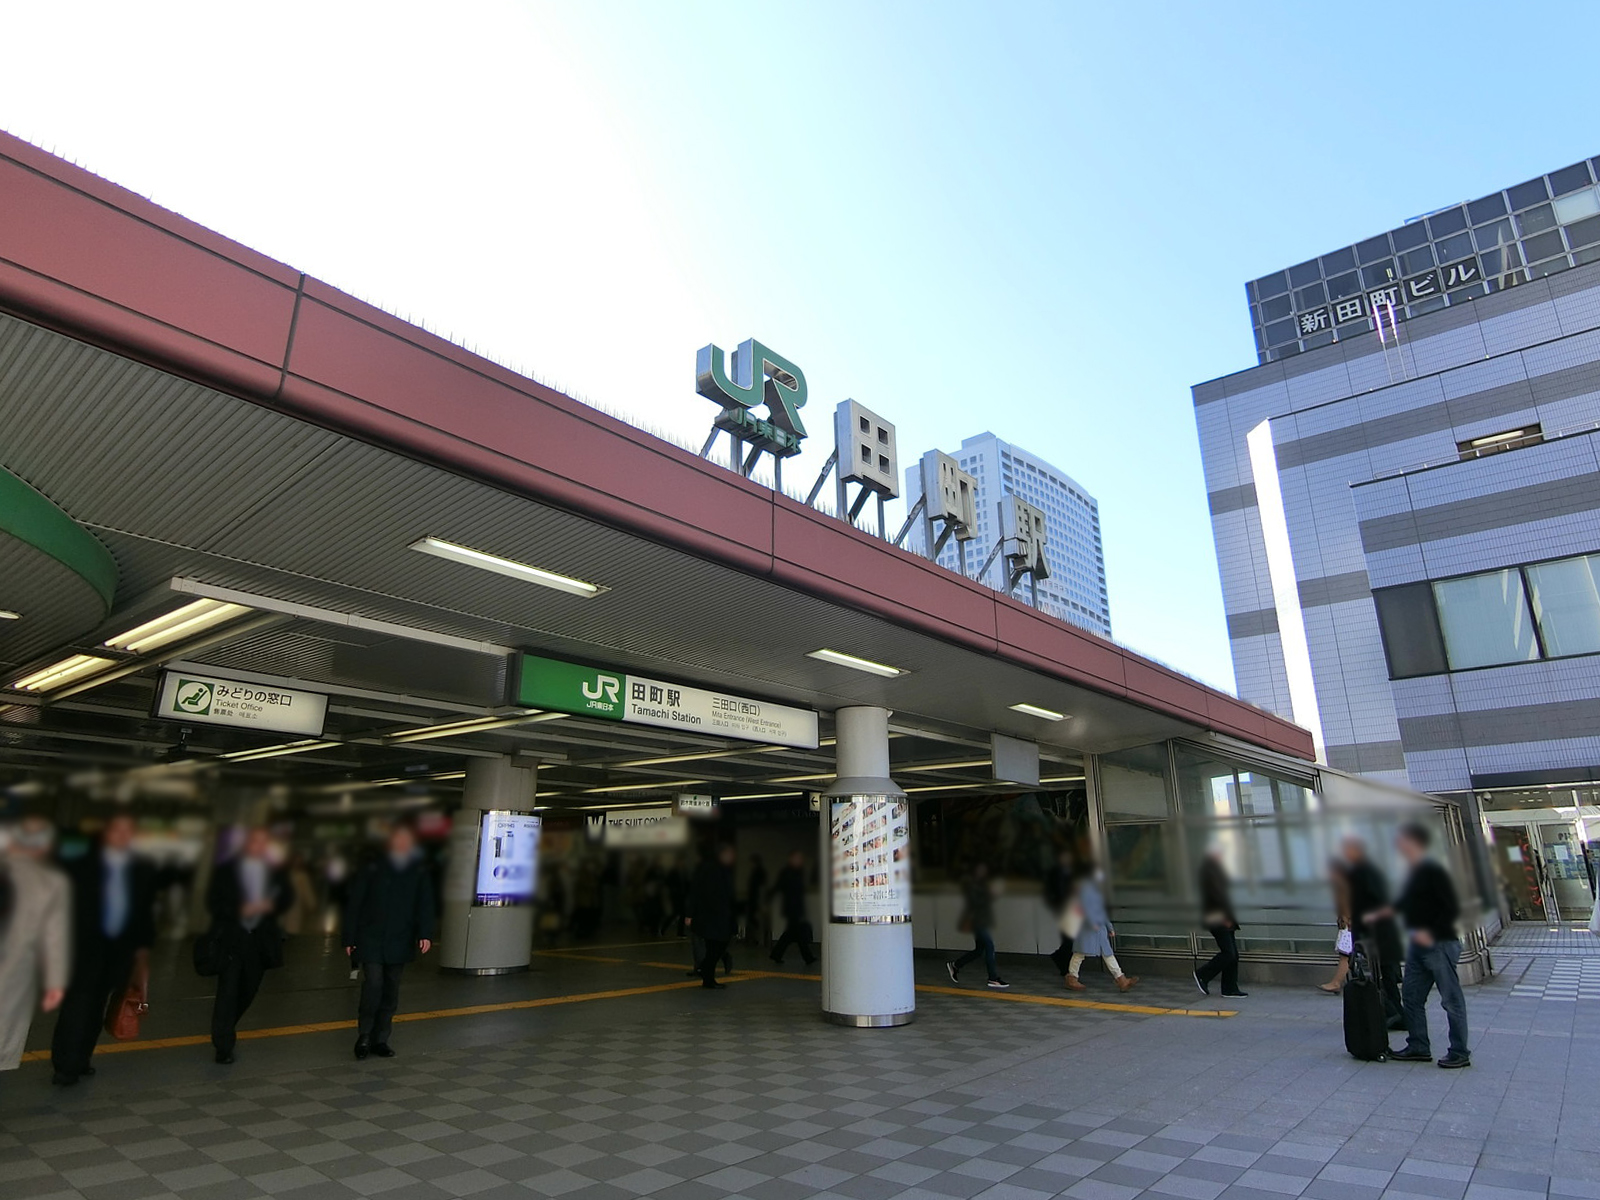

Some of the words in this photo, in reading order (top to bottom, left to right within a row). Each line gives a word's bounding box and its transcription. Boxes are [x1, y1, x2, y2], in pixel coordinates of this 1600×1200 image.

[1300, 264, 1476, 333] 新田町ビル
[697, 338, 808, 438] JR
[722, 406, 803, 458] JR東日本
[217, 685, 292, 706] みどりの窓口
[582, 674, 620, 703] JR
[631, 682, 680, 708] 田町駅
[216, 699, 239, 708] Ticket
[240, 702, 263, 712] Office
[587, 701, 614, 711] JR東日本
[631, 703, 670, 719] Tamachi
[671, 710, 702, 725] Station
[712, 696, 761, 717] 三田口(西口)
[724, 713, 745, 722] Entrance
[760, 719, 782, 729] Entrance)
